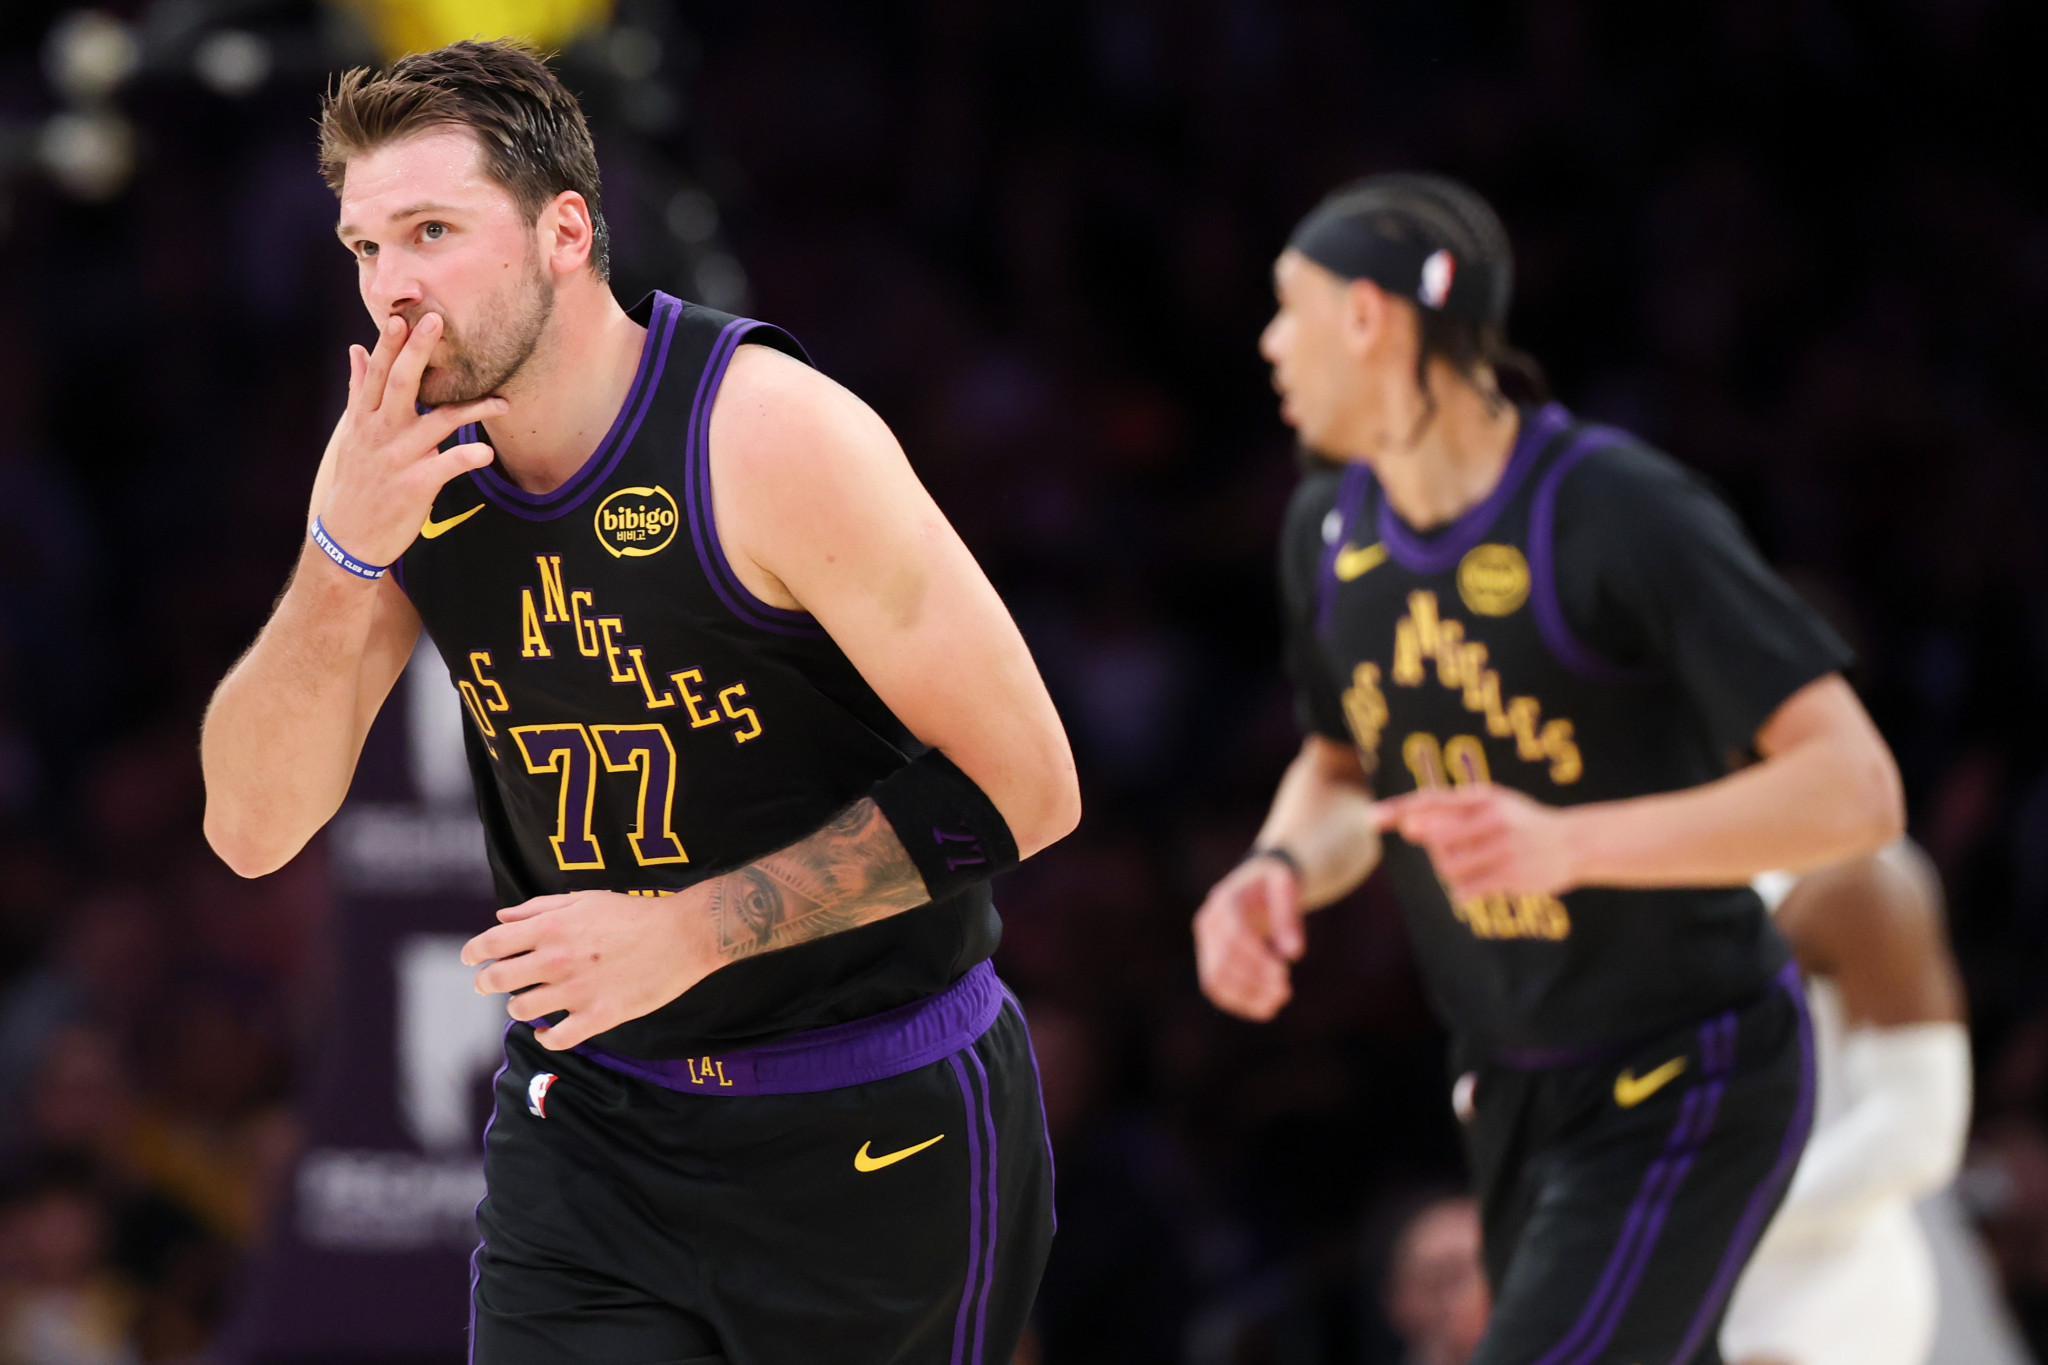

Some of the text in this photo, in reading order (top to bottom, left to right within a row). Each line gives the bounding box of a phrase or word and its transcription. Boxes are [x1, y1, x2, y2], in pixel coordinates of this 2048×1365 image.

[603, 505, 674, 535] bibigo
[616, 529, 646, 542] 비비고
[315, 531, 345, 564] RYKER
[458, 556, 763, 760] OS ANGELES
[1392, 588, 1584, 786] ANGELES
[508, 723, 689, 870] 77
[687, 1056, 732, 1086] LAL
